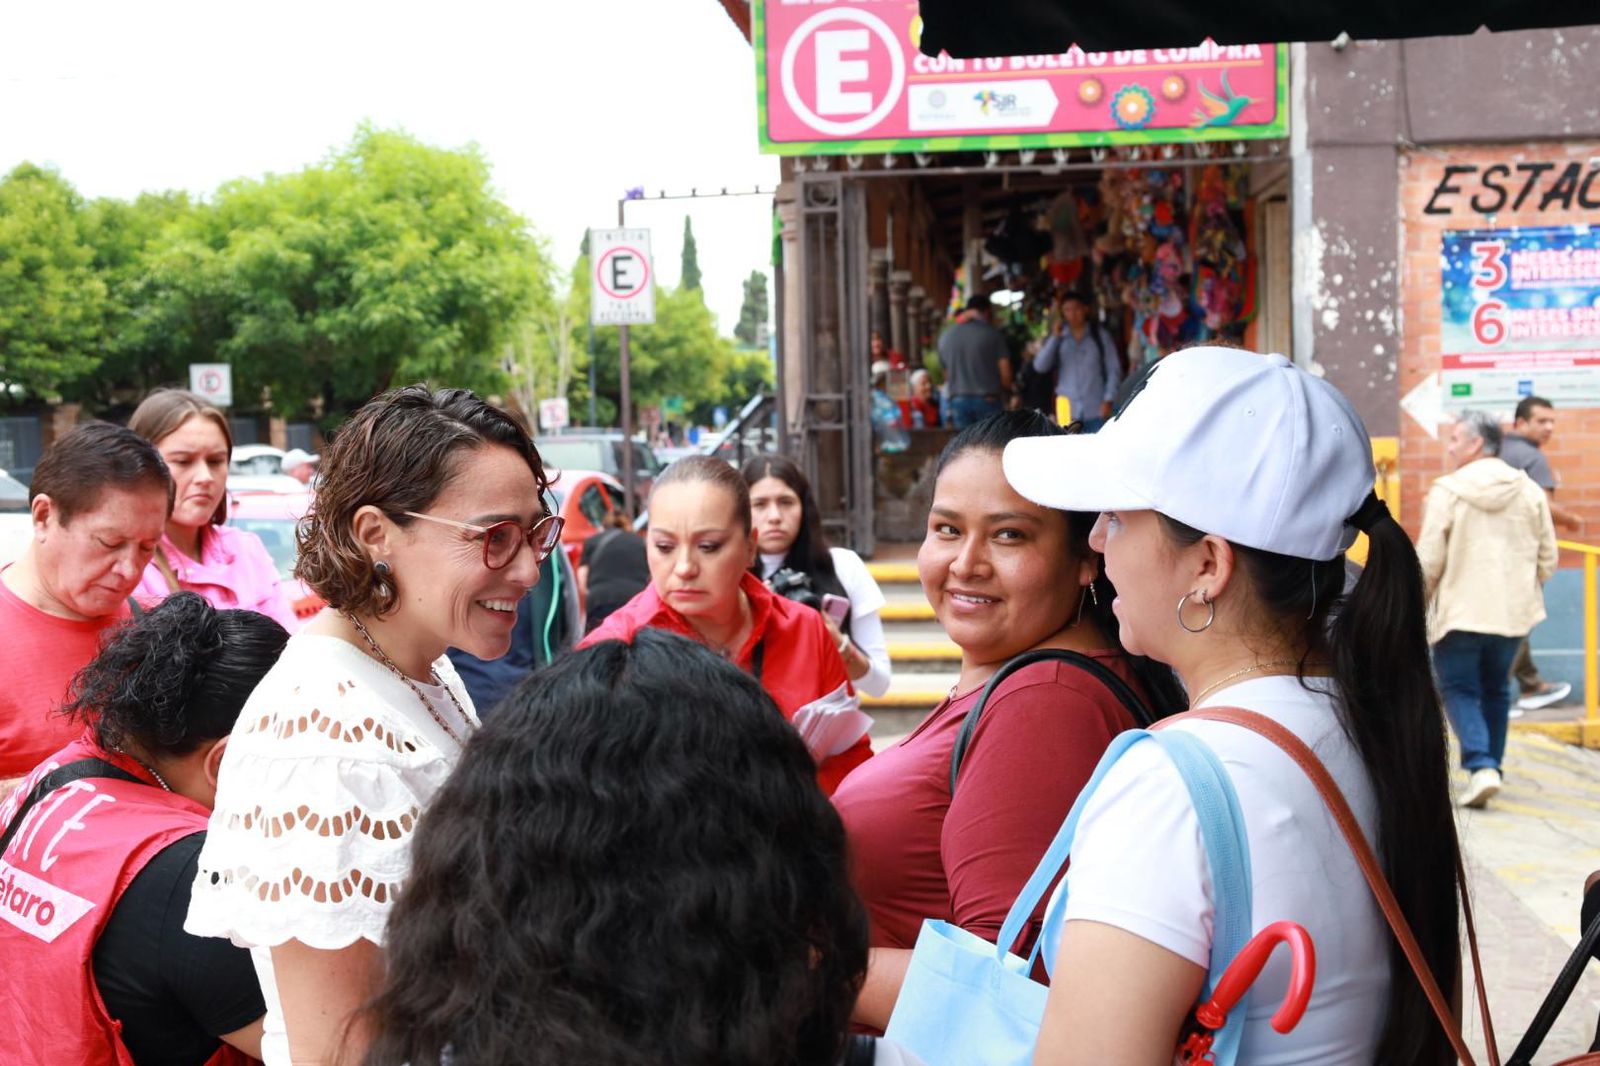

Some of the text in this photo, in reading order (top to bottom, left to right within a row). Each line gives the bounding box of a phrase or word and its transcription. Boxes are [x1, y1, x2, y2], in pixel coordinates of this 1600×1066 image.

[815, 29, 873, 115] E
[913, 51, 965, 73] CON
[1009, 43, 1107, 70] BOLETO
[1153, 38, 1262, 63] COMPRA
[612, 255, 634, 291] E
[1472, 242, 1506, 291] 3
[1472, 301, 1507, 347] 6
